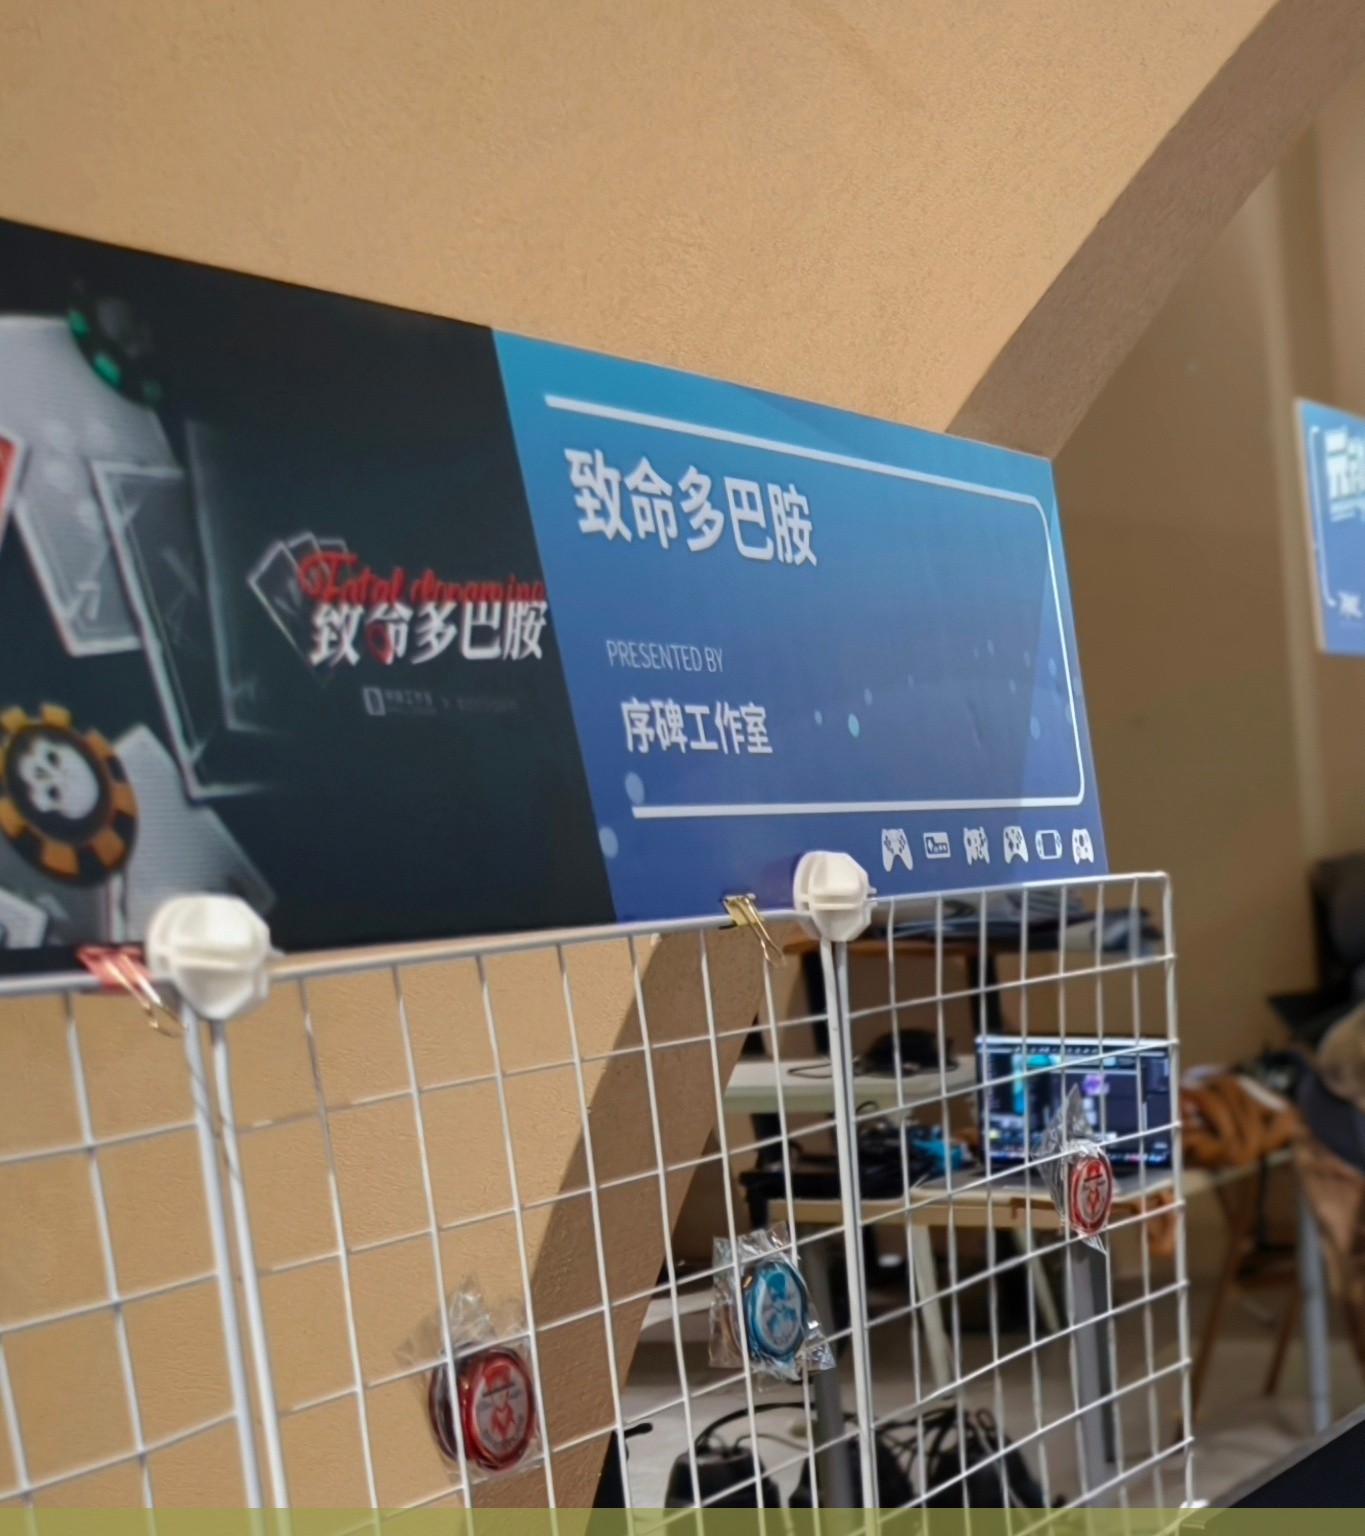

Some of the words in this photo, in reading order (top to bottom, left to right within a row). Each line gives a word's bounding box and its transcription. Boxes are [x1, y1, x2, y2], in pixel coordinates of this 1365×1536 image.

[564, 448, 818, 566] 致命多巴胺
[307, 600, 549, 667] 致命多巴胺
[606, 639, 702, 672] PRESENTED
[704, 646, 724, 673] BY
[620, 697, 774, 755] 序碑工作室
